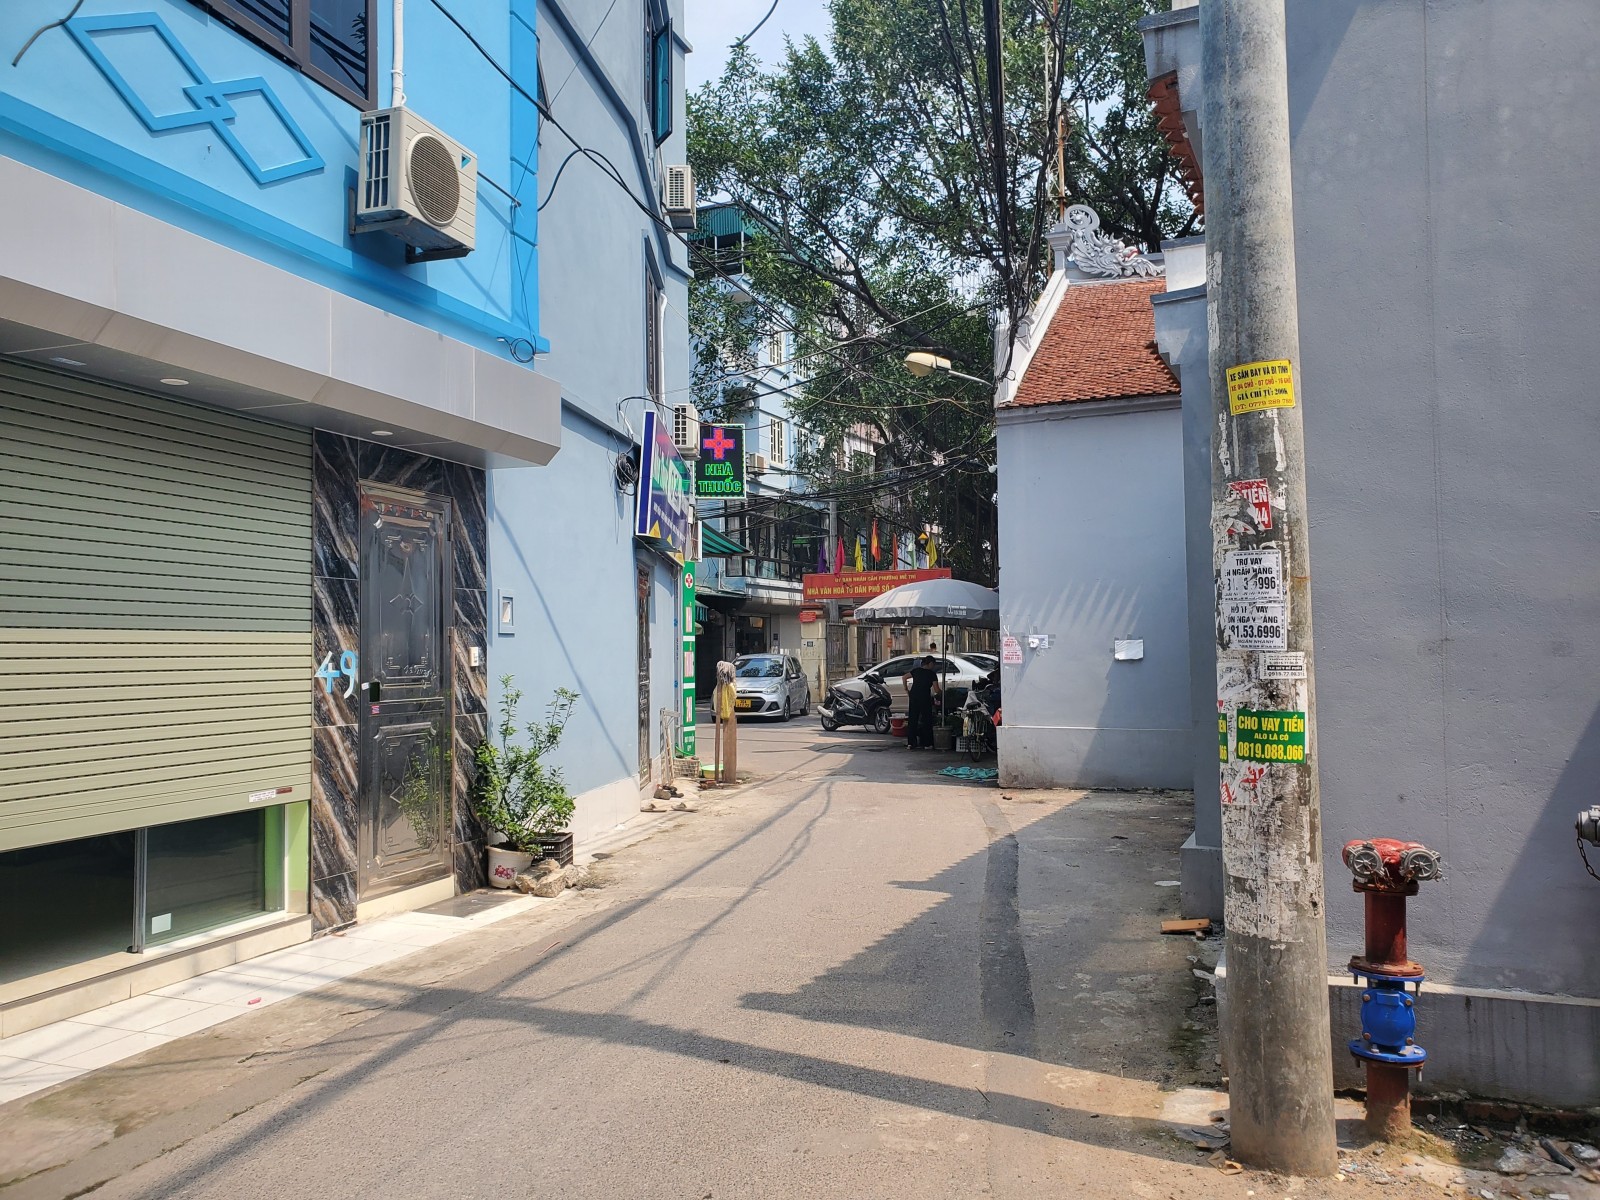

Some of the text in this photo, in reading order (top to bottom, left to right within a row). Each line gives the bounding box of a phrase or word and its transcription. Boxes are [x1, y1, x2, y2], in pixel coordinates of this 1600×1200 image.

[1230, 373, 1236, 381] XE
[1250, 368, 1261, 378] BAY
[705, 462, 733, 476] NHÀ
[698, 476, 742, 492] THUỐC
[314, 650, 357, 699] 49
[1238, 716, 1258, 730] CHO
[1262, 718, 1280, 732] VAY
[1269, 732, 1278, 740] LÀ
[1280, 732, 1290, 741] CÓ
[1238, 742, 1304, 760] 0819.088.066
